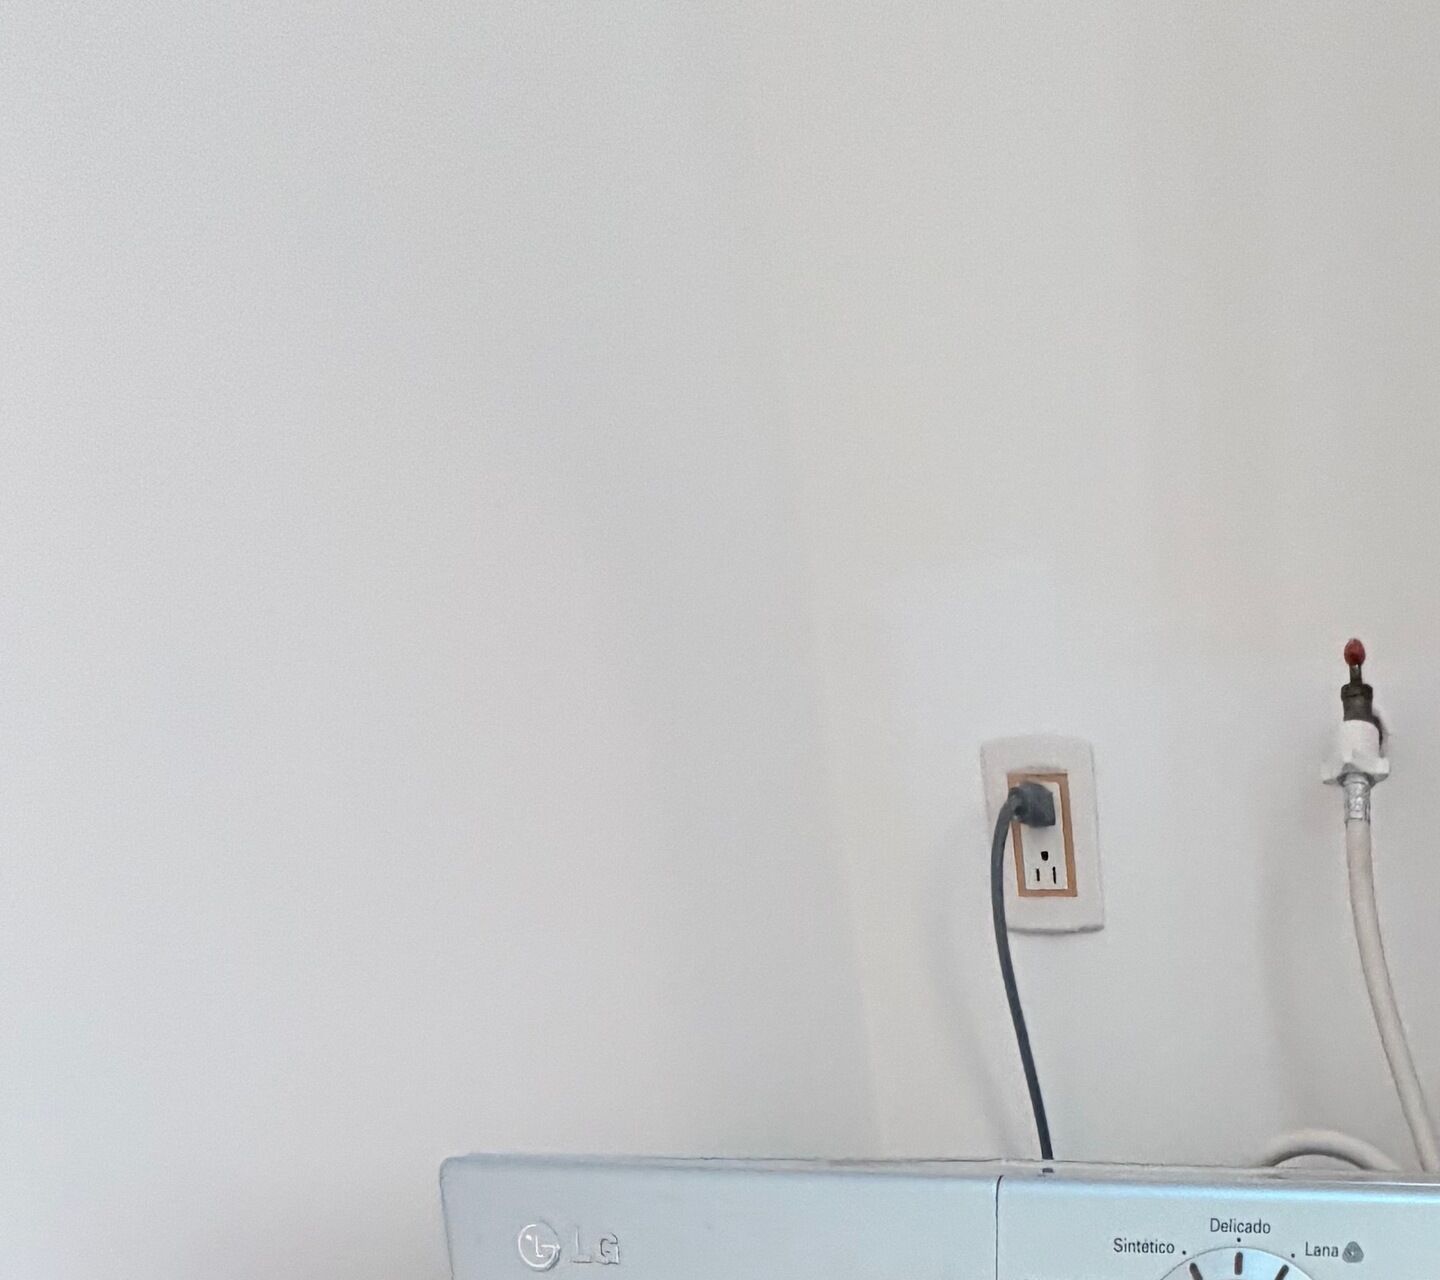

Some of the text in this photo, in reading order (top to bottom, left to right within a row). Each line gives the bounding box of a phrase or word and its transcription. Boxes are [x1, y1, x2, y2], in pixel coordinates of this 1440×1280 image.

[1210, 1218, 1271, 1235] Delicado
[570, 1225, 620, 1265] LG
[1113, 1237, 1175, 1255] Sintético
[1304, 1241, 1339, 1258] Lana
